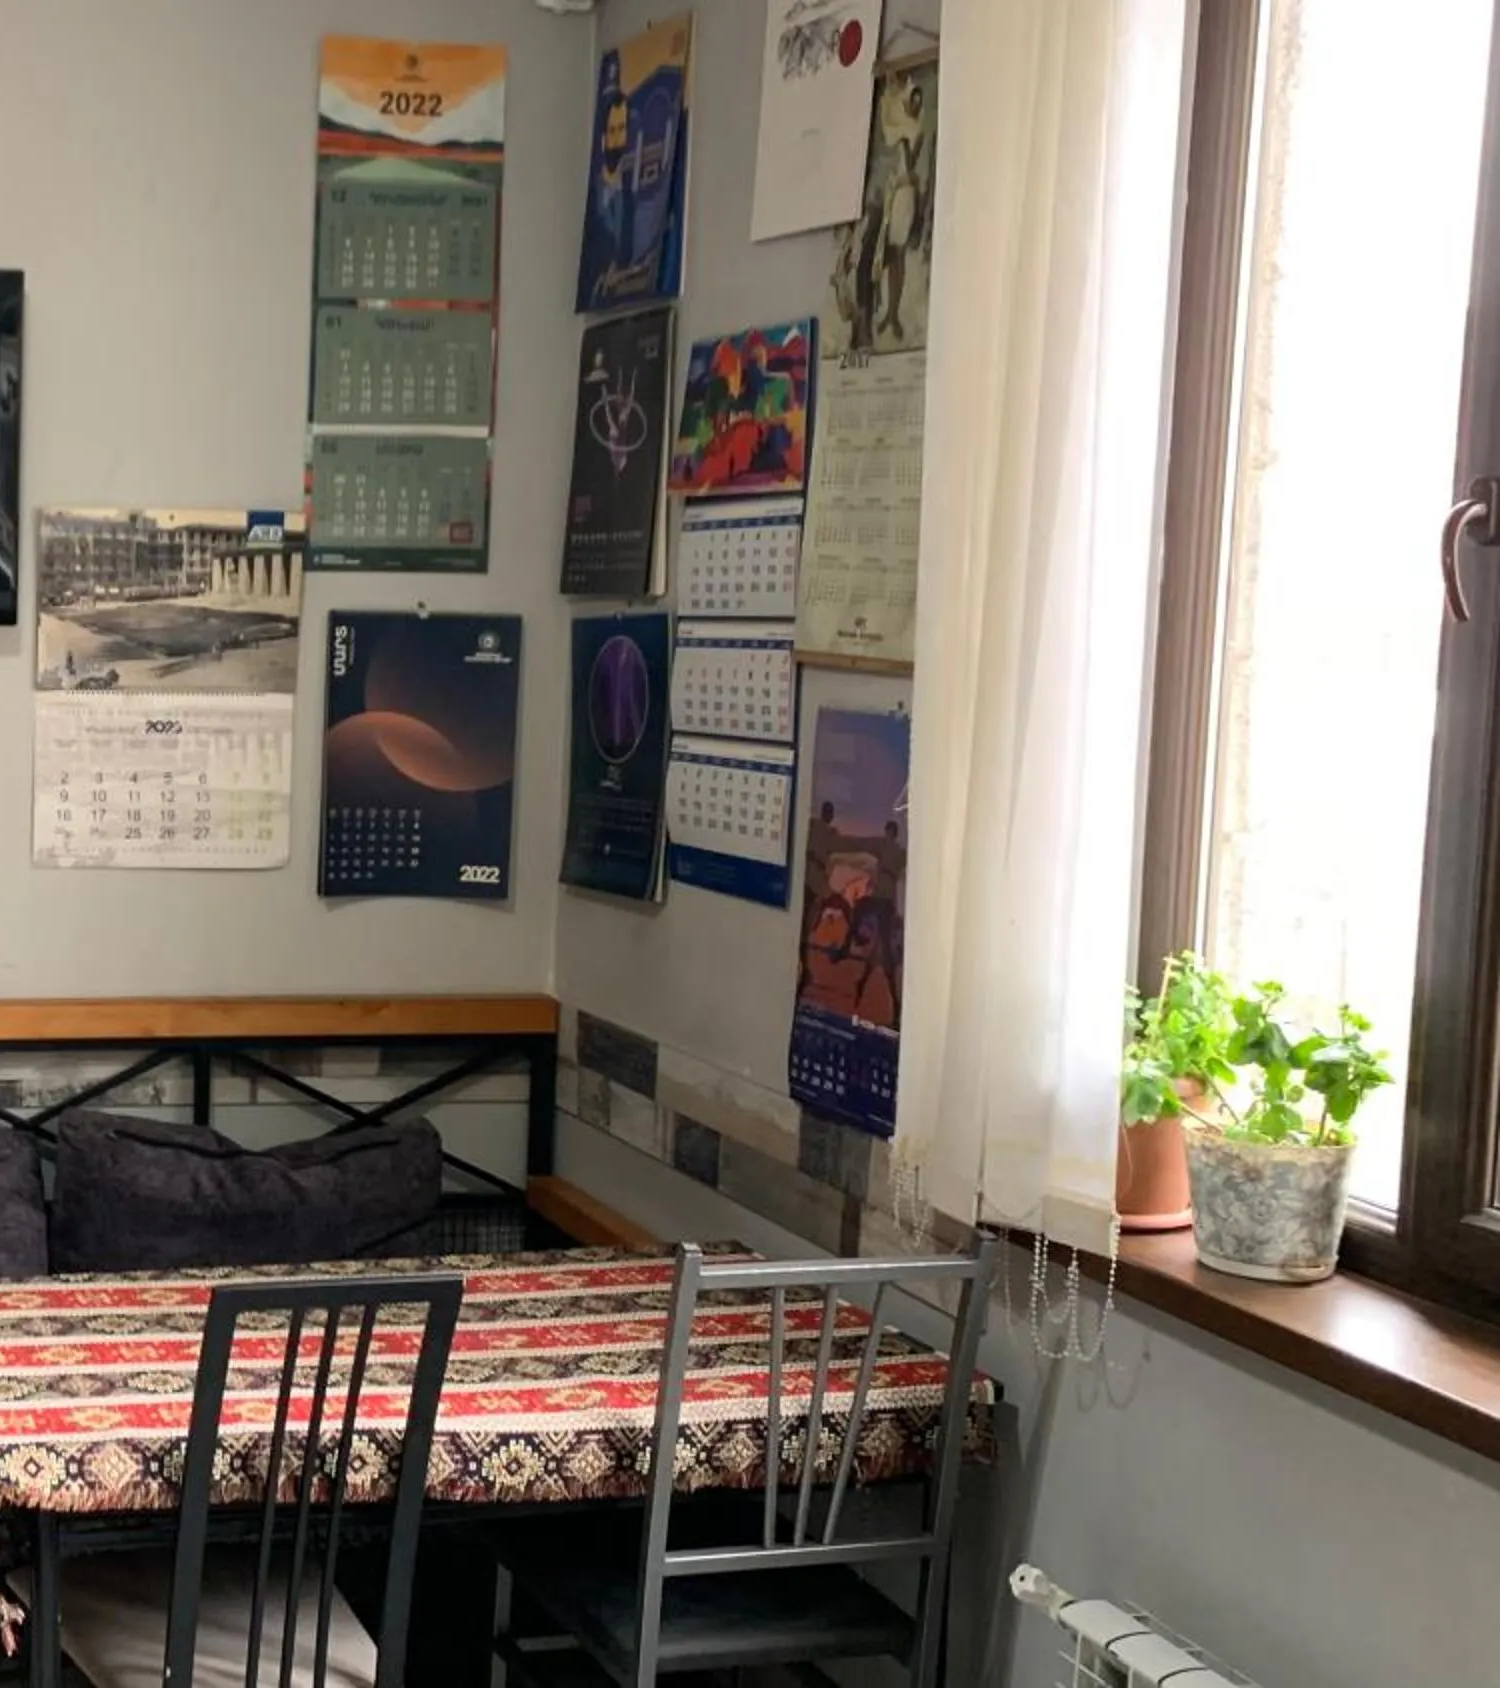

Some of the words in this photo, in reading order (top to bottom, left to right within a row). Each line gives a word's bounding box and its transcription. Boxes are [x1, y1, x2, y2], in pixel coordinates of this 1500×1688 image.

[380, 91, 443, 117] 2022
[129, 771, 138, 784] 4
[91, 789, 107, 803] 10
[128, 790, 142, 802] 11
[160, 790, 175, 803] 12
[91, 808, 107, 822] 17
[126, 808, 141, 821] 18
[160, 808, 175, 822] 19
[192, 808, 211, 822] 20
[124, 827, 142, 840] 25
[192, 827, 210, 840] 27
[459, 865, 501, 884] 2022
